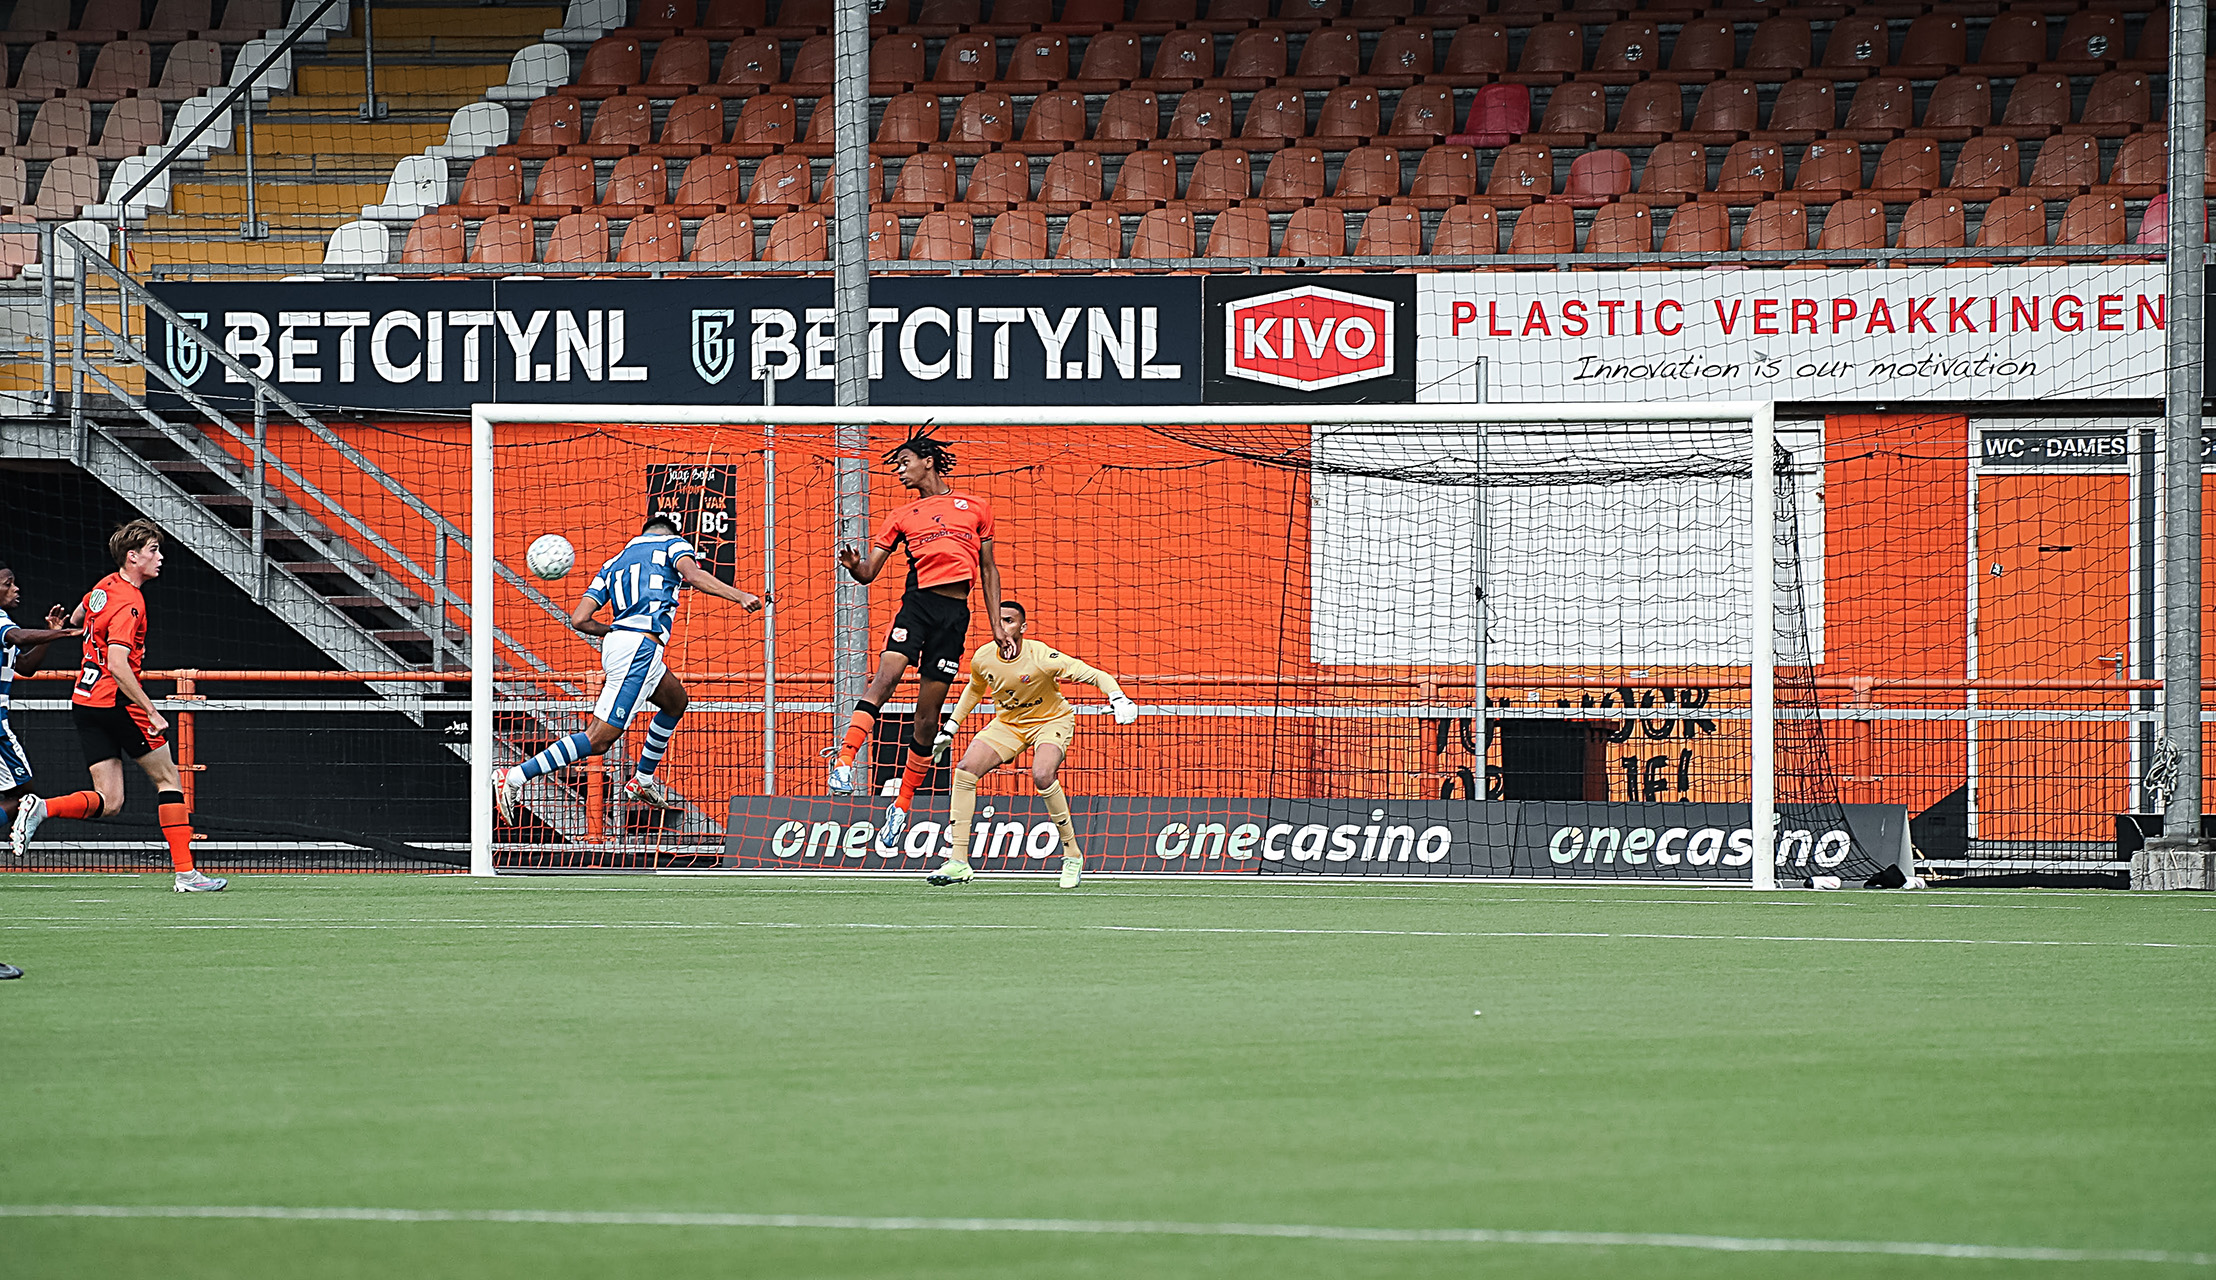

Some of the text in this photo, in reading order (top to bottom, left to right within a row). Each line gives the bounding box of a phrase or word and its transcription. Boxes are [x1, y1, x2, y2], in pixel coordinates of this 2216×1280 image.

[1451, 293, 2166, 337] PLASTIC VERPAKKINGEN
[224, 309, 648, 384] BETCITY.NL
[750, 306, 1182, 381] BETCITY.NL
[1242, 315, 1377, 360] KIVO
[1573, 351, 2038, 381] Innovation is our motivation
[1985, 437, 2025, 458] WC
[2046, 437, 2126, 458] DAMES
[657, 496, 680, 509] VAK
[701, 511, 729, 533] BC
[704, 496, 727, 509] VAK
[1154, 807, 1453, 863] onecasino
[1549, 811, 1851, 868] onecasno
